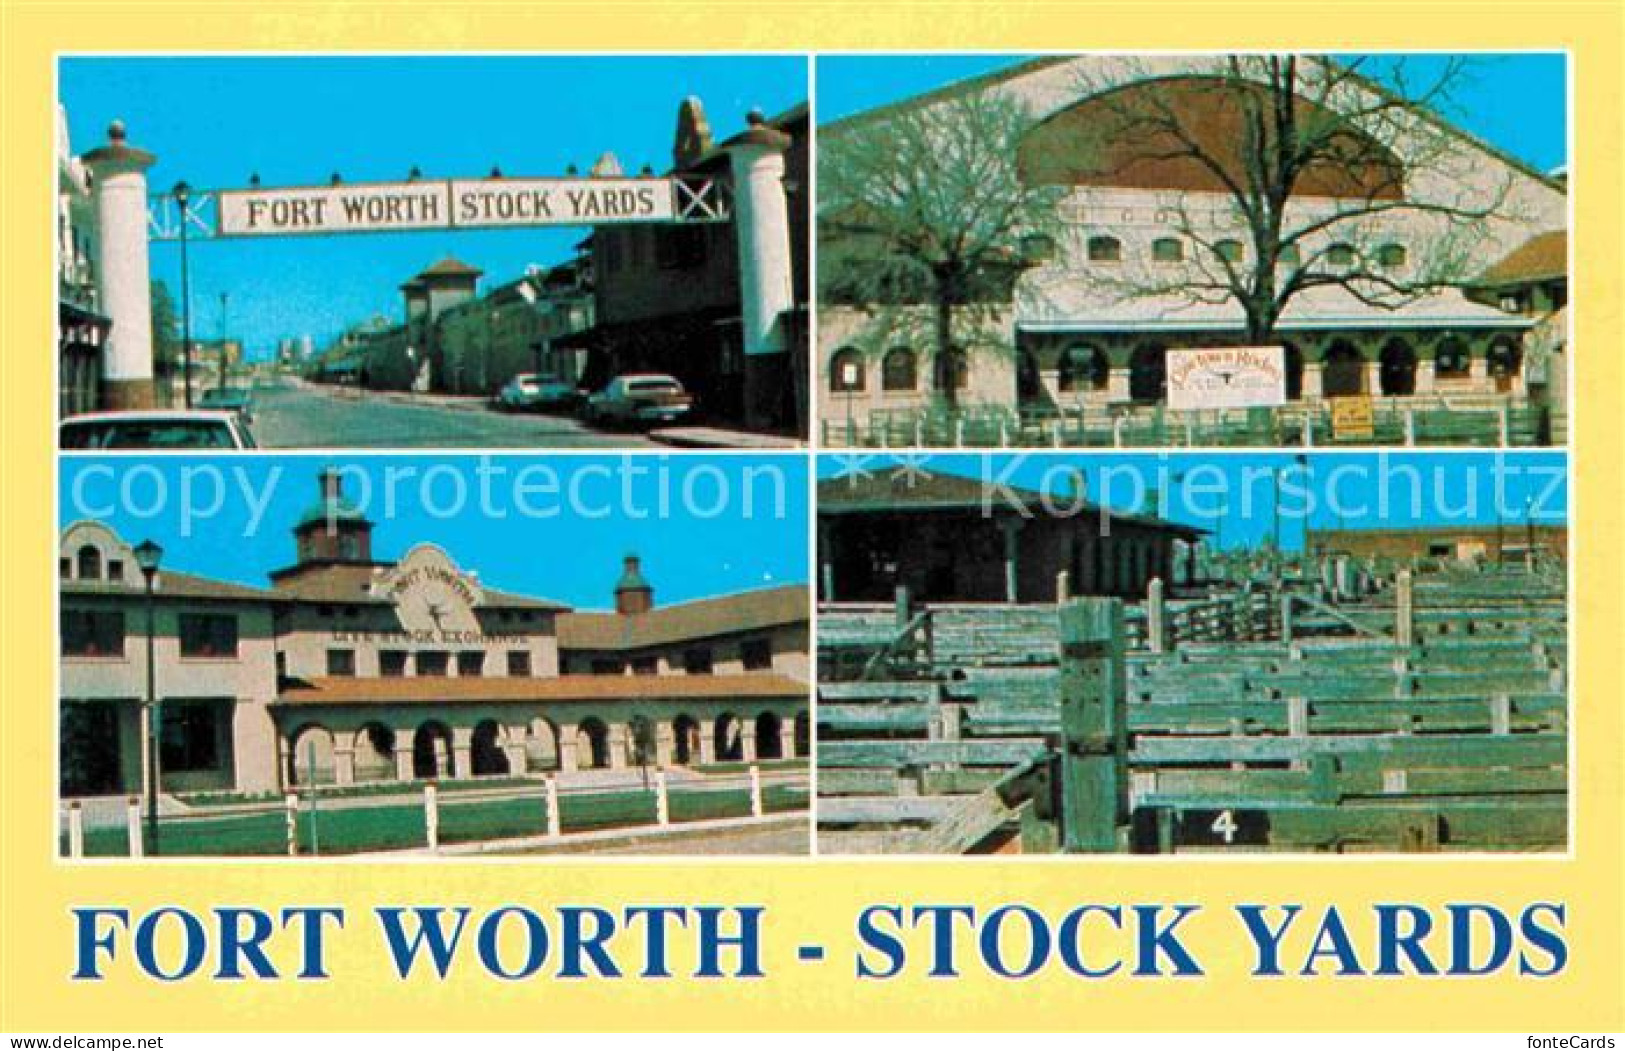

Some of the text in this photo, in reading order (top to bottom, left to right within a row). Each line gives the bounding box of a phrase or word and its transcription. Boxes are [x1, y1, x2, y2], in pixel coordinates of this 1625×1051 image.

[247, 187, 655, 227] FORT WORTH STOCK YARDS
[1211, 809, 1238, 843] 4
[74, 907, 343, 979] FORT
[376, 907, 764, 979] WORTH
[857, 904, 1201, 978] STOCK
[1236, 904, 1567, 977] YARDS
